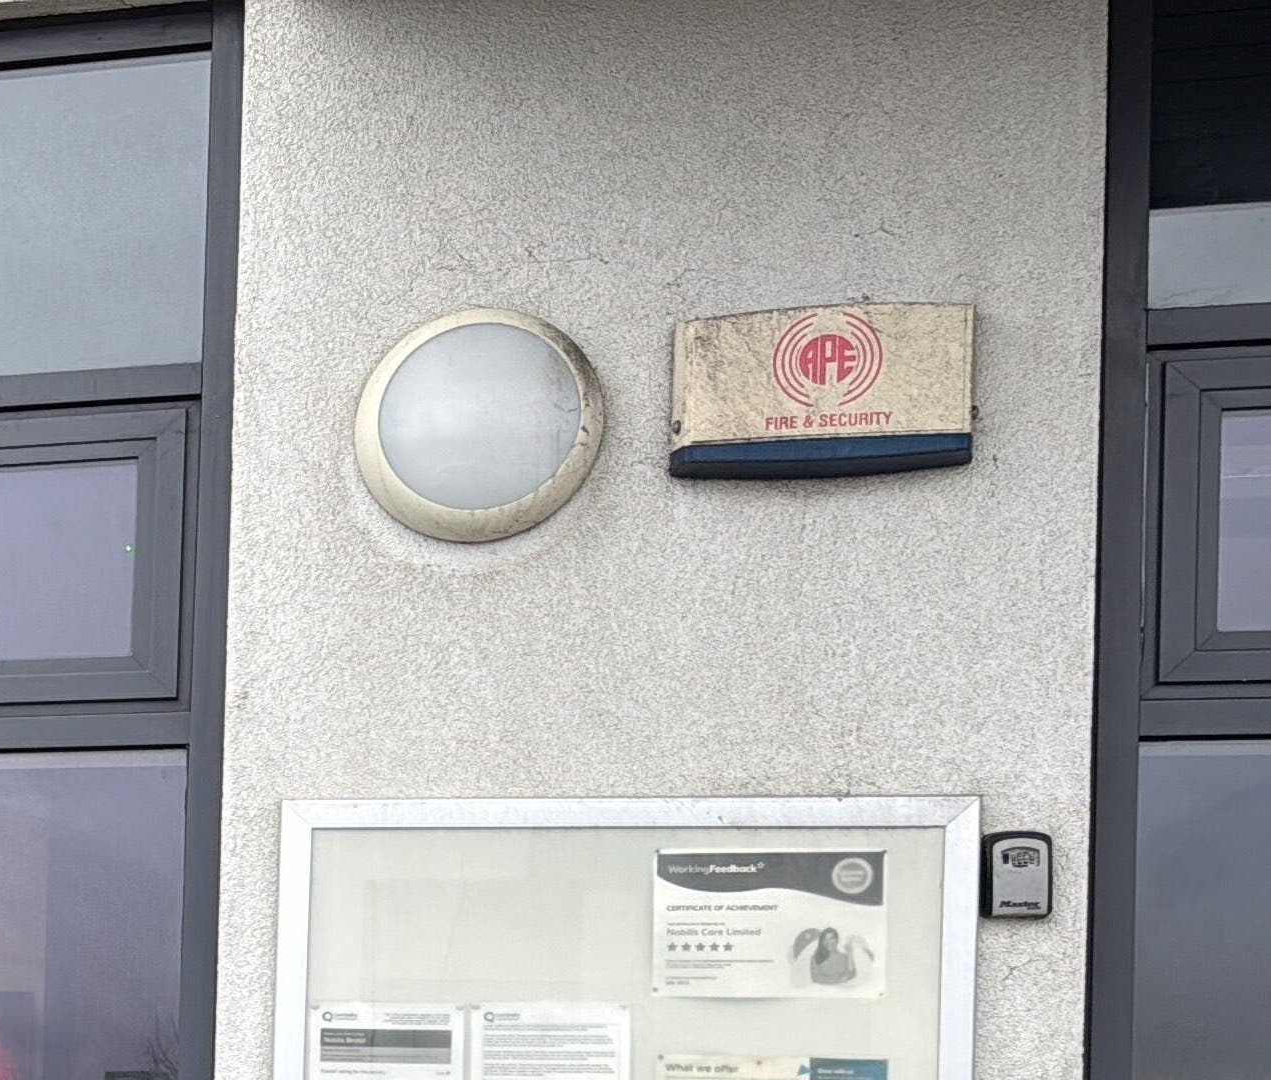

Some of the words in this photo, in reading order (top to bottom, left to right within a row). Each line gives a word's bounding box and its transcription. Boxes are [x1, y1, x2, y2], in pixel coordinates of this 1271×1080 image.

[799, 333, 858, 386] APE
[765, 414, 798, 431] FIRE
[803, 414, 814, 428] &
[819, 411, 893, 428] SECURITY
[665, 904, 712, 912] CERTIFICATE
[714, 904, 725, 912] OF
[726, 904, 778, 912] ACHIEVEMENT
[701, 927, 724, 937] Care
[726, 926, 762, 937] Limited
[665, 1063, 694, 1073] What
[696, 1065, 712, 1073] we
[714, 1064, 739, 1074] offer
